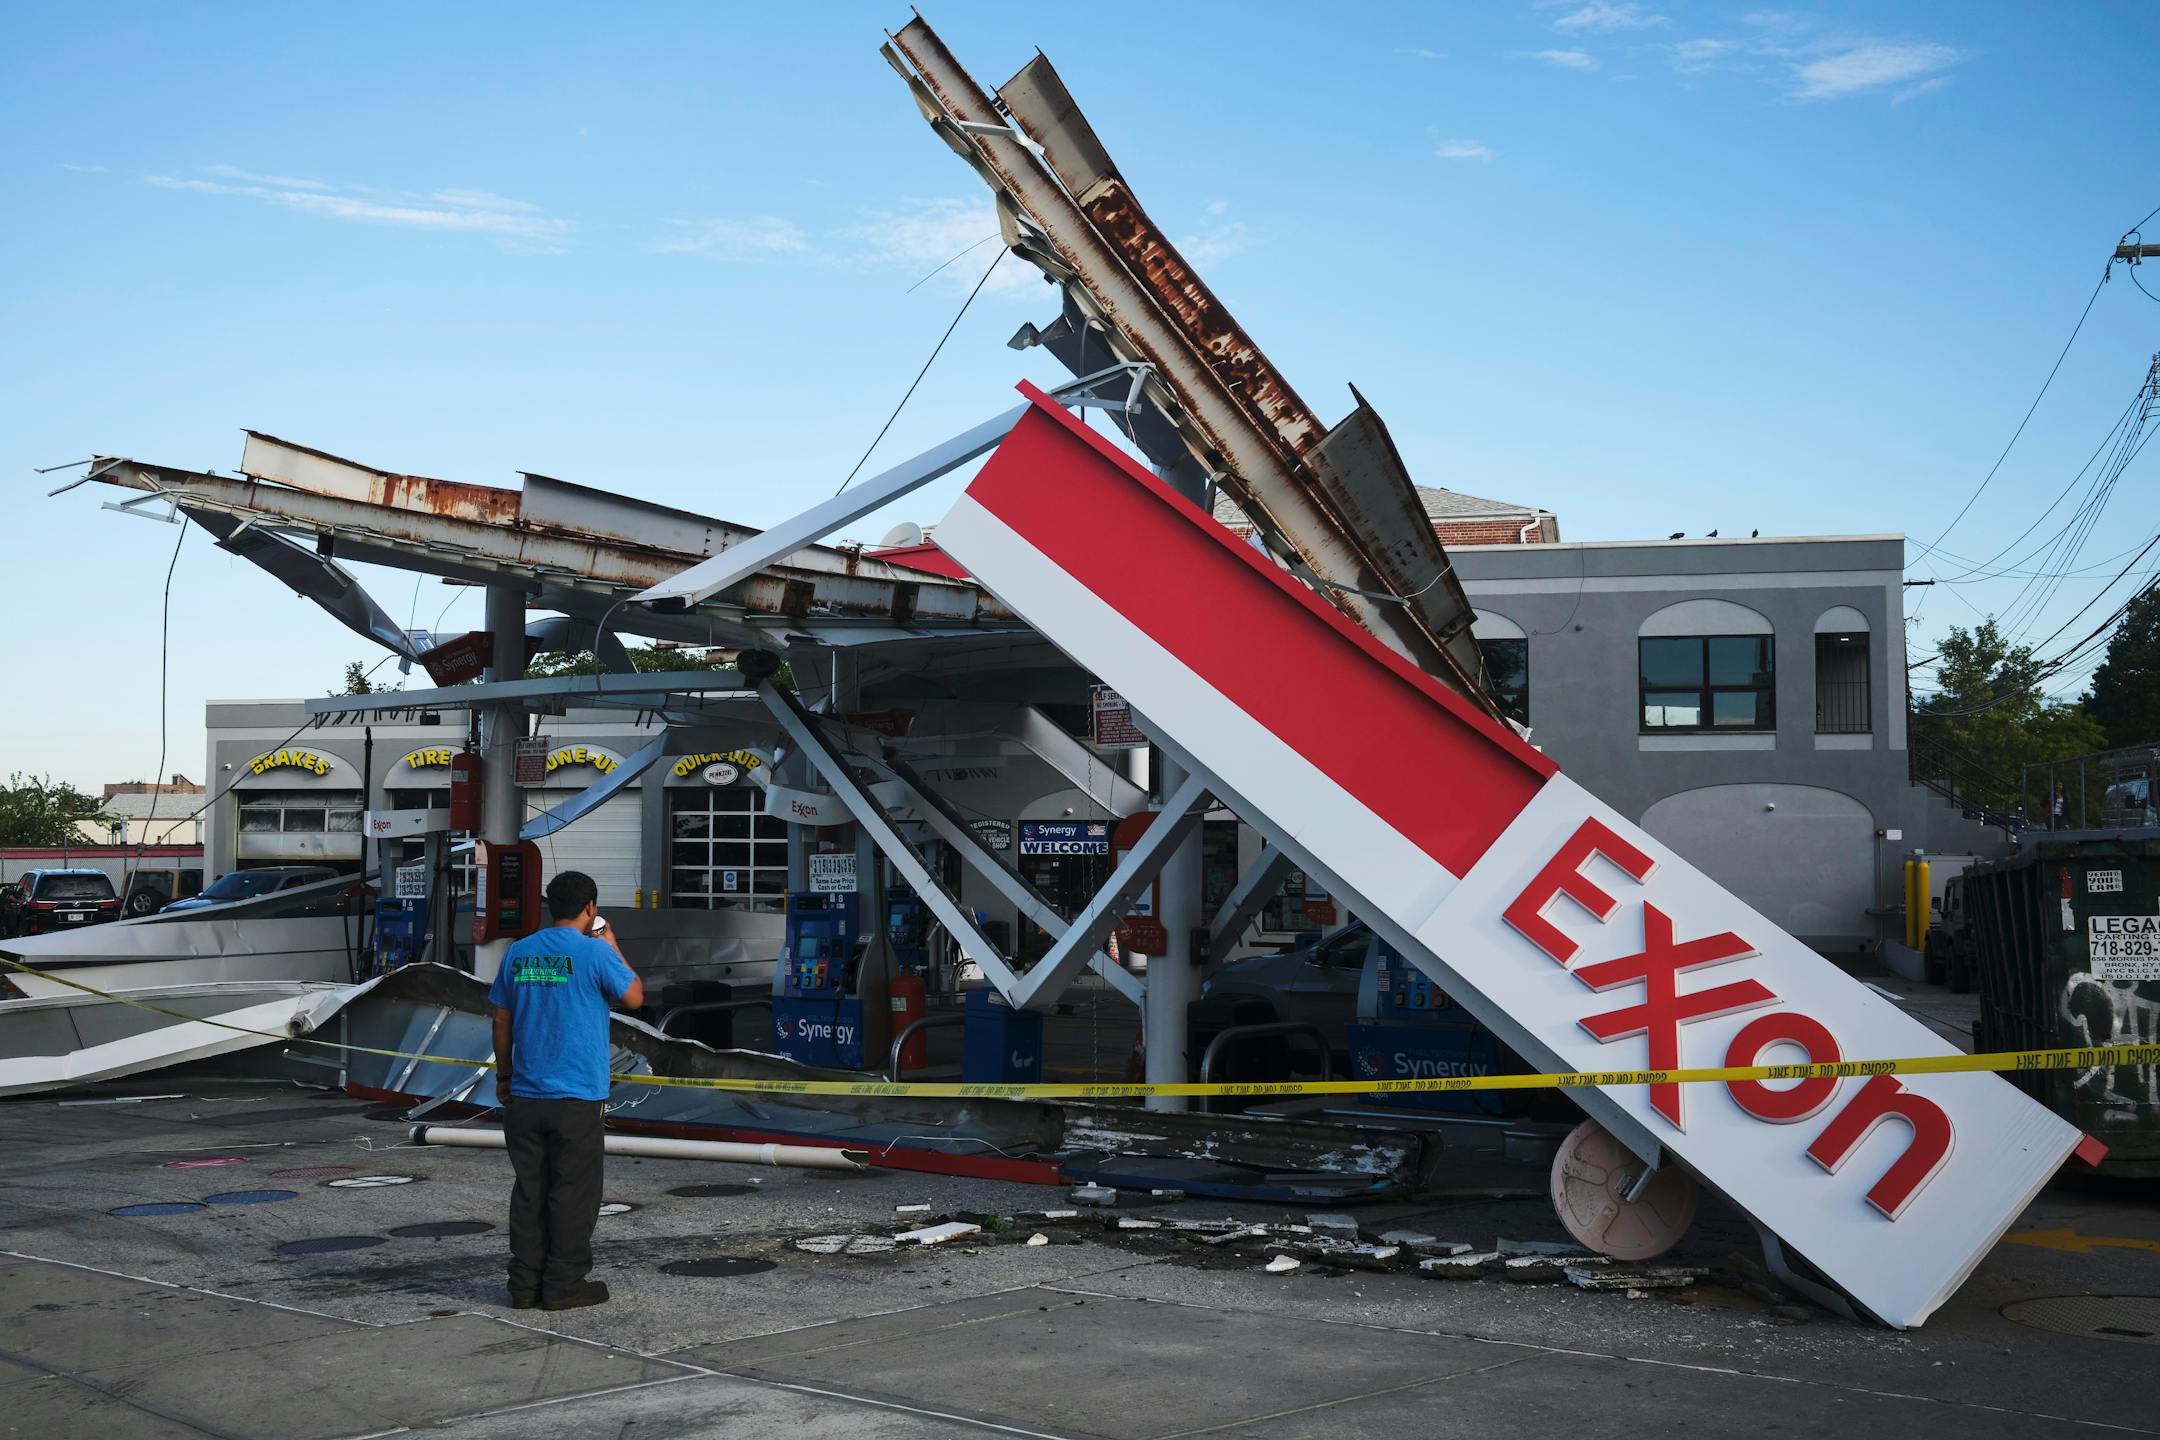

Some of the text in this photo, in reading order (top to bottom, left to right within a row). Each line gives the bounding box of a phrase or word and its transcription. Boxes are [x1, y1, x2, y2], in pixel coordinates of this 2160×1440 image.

[441, 651, 478, 673] Synergy
[249, 751, 330, 776] BRAKES
[405, 750, 451, 769] TIRE
[546, 749, 614, 774] UNE-U
[673, 750, 761, 777] QUICK-LUB
[791, 800, 818, 818] Exxon
[373, 820, 391, 832] Exxon
[1038, 824, 1077, 837] Synergy
[1023, 842, 1108, 854] WELCOME
[2092, 918, 2160, 934] LEGA
[2091, 941, 2160, 956] 718-829-
[512, 956, 575, 976] STANZA
[1503, 816, 1956, 1221] Exxon
[798, 1018, 855, 1045] Synergy
[1393, 1052, 1488, 1078] Synergy
